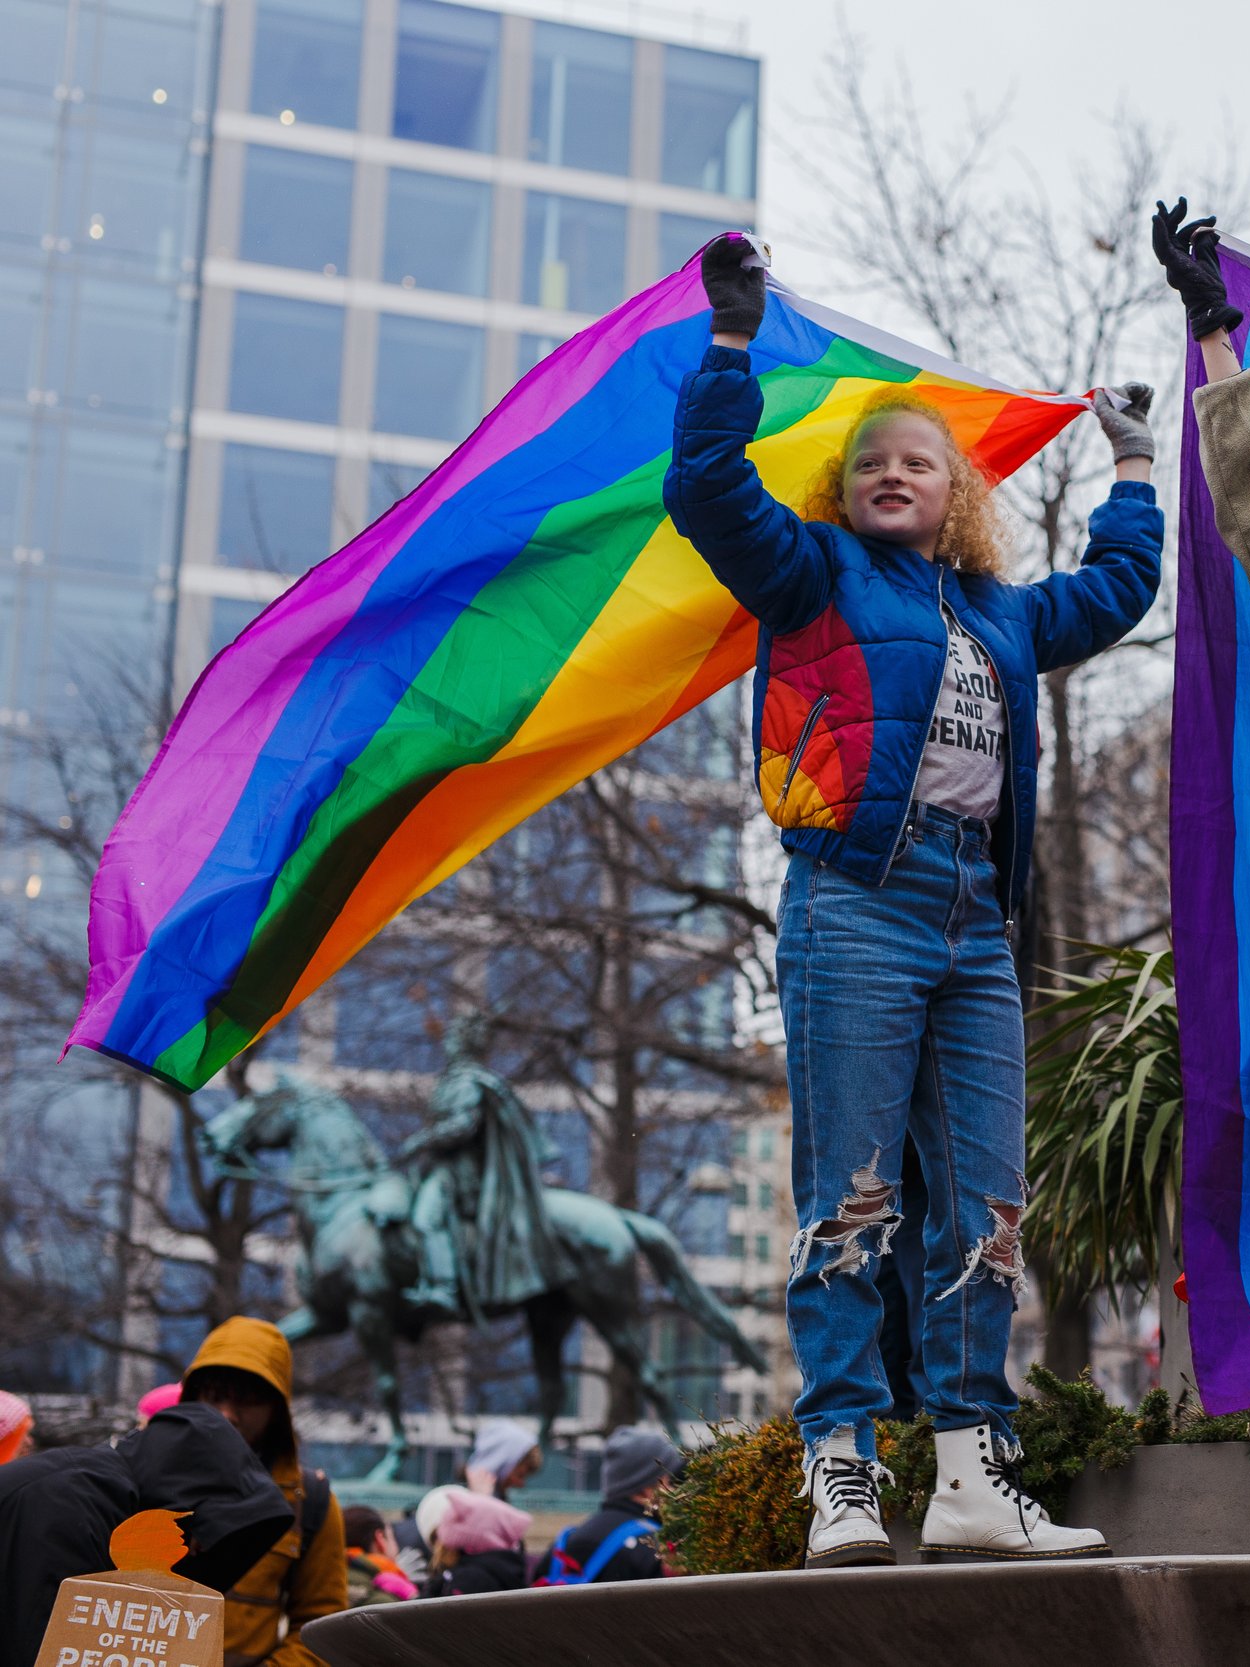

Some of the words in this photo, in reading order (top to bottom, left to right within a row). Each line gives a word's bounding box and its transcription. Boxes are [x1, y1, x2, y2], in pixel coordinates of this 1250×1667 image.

[954, 667, 1001, 703] HOU
[954, 699, 983, 721] AND
[66, 1595, 211, 1640] ENEMY
[98, 1632, 126, 1649] OF
[130, 1636, 169, 1655] THE
[55, 1647, 201, 1667] PEO
